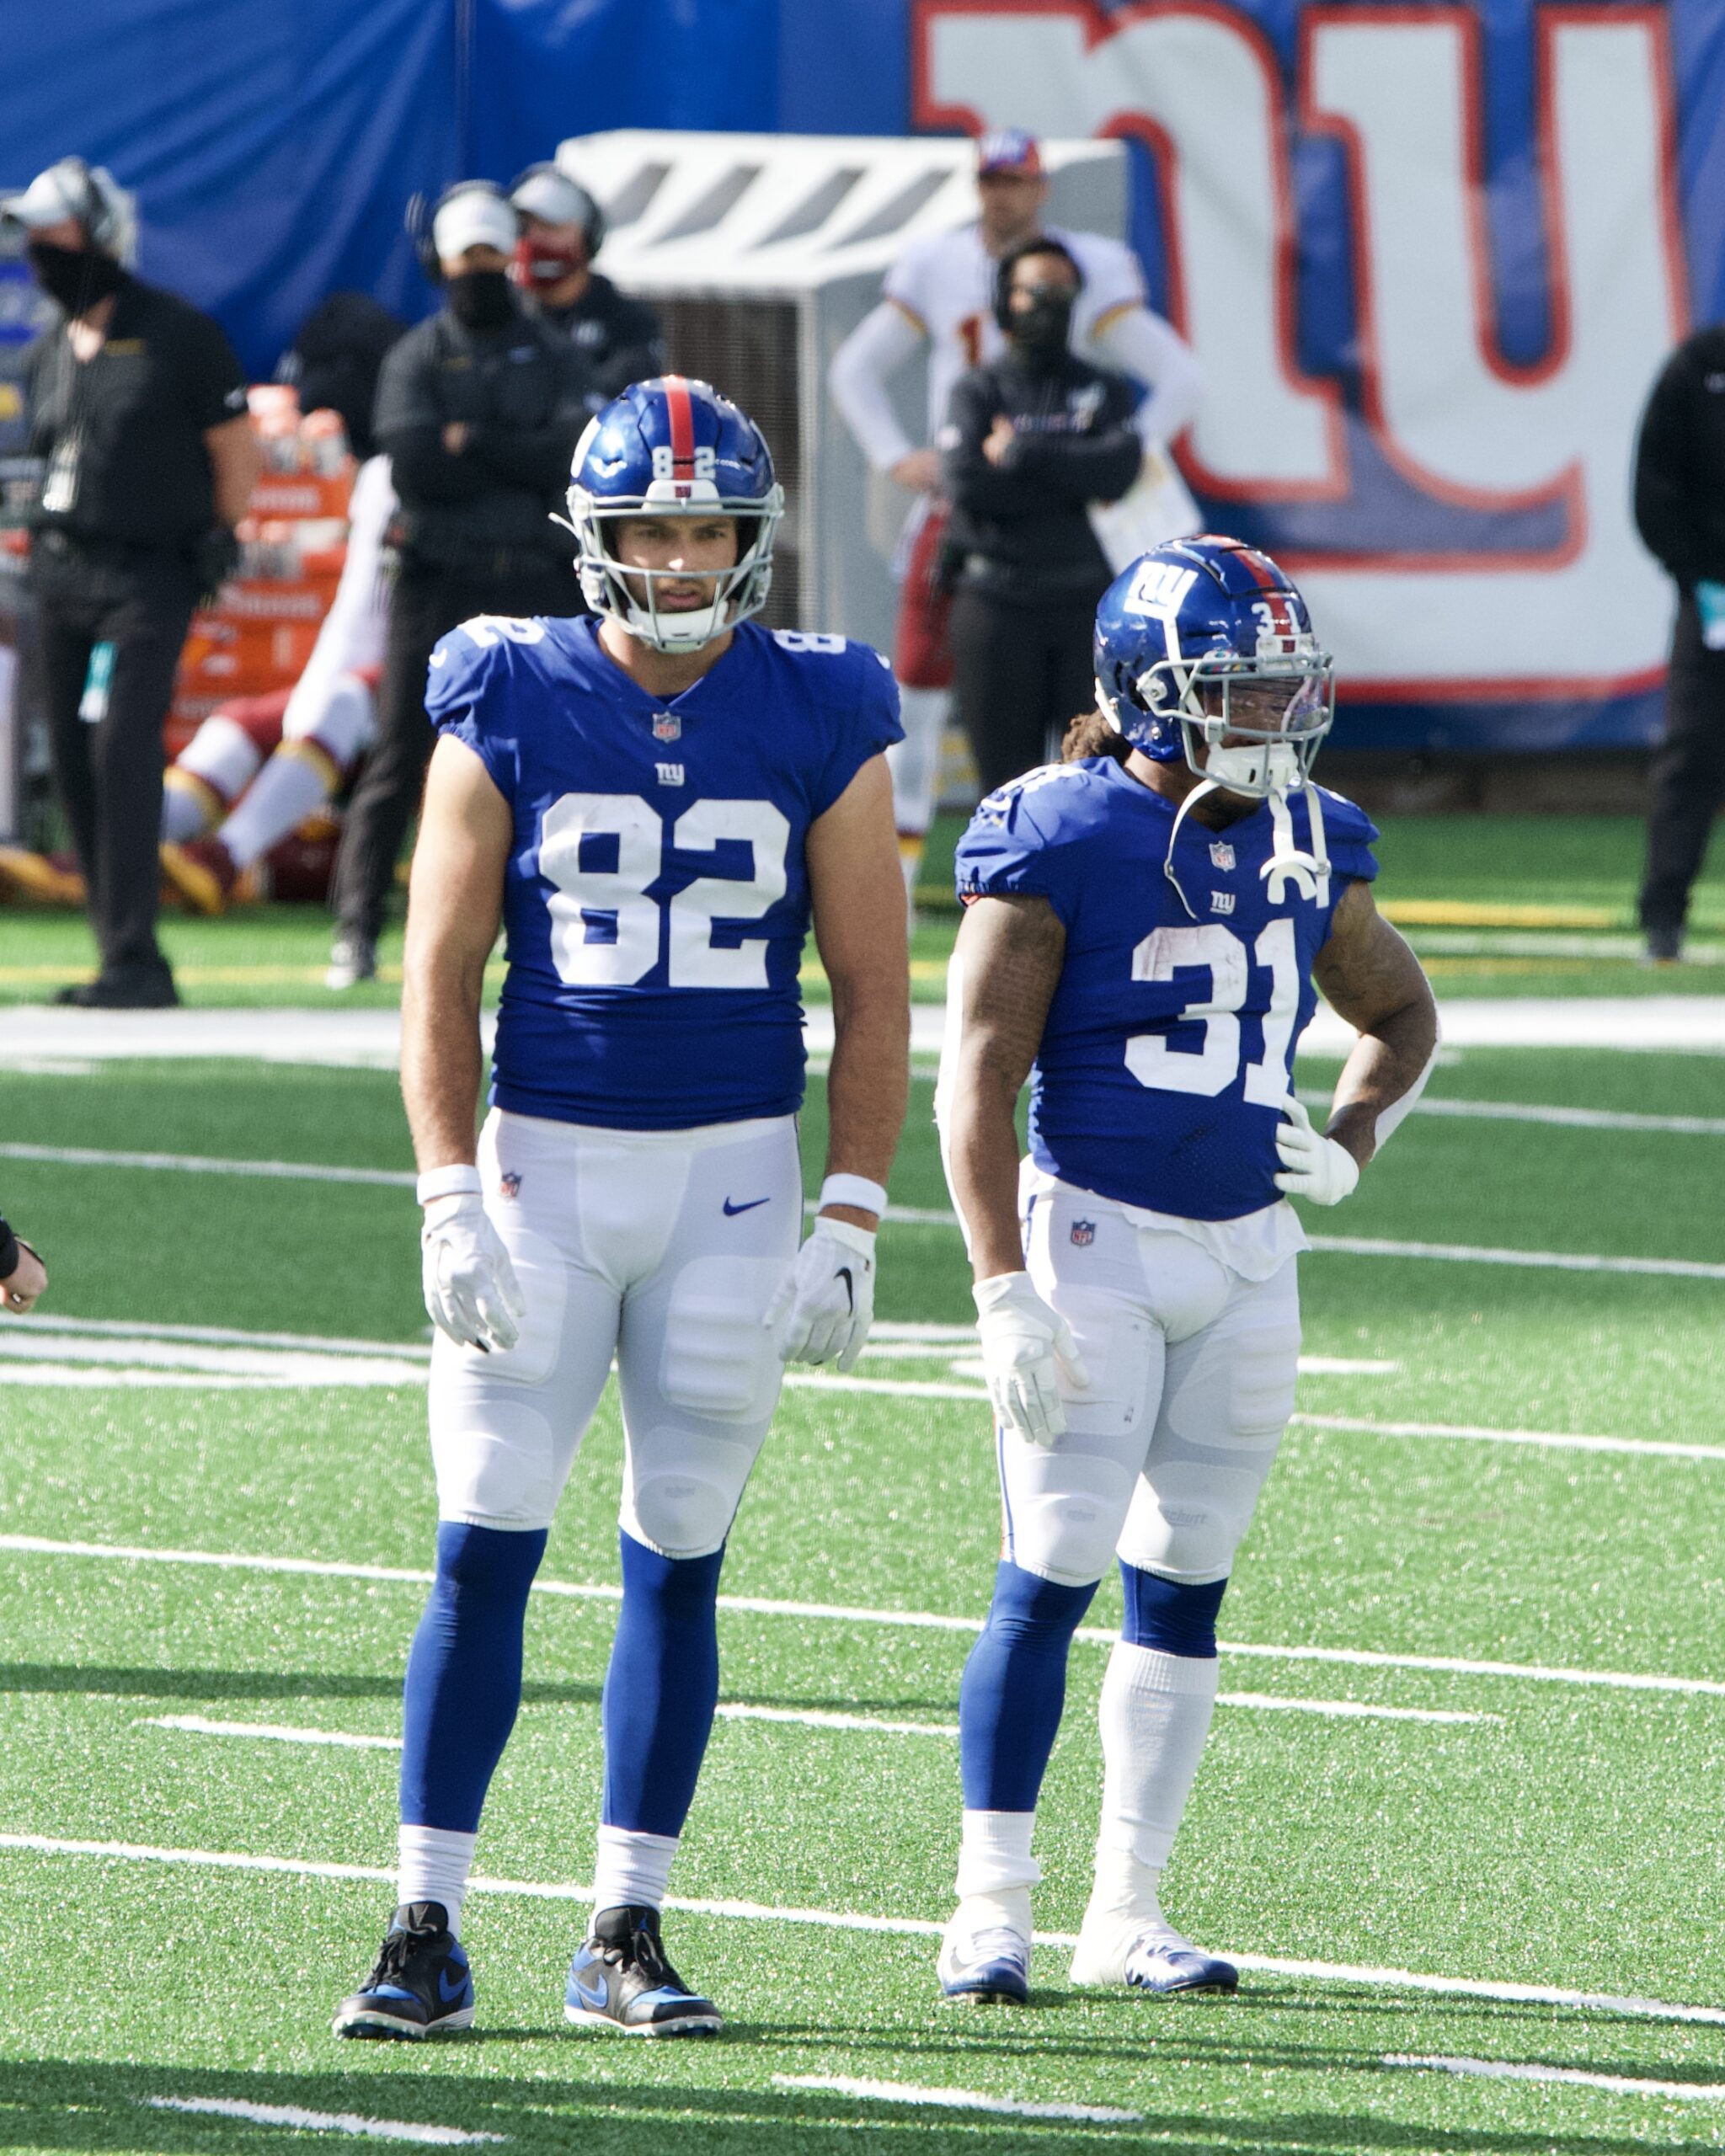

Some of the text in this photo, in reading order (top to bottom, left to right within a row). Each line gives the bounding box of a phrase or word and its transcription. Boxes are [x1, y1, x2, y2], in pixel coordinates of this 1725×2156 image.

[652, 446, 716, 481] 82
[1252, 601, 1301, 635] 31
[538, 792, 791, 990] 82
[1124, 918, 1300, 1110] 31
